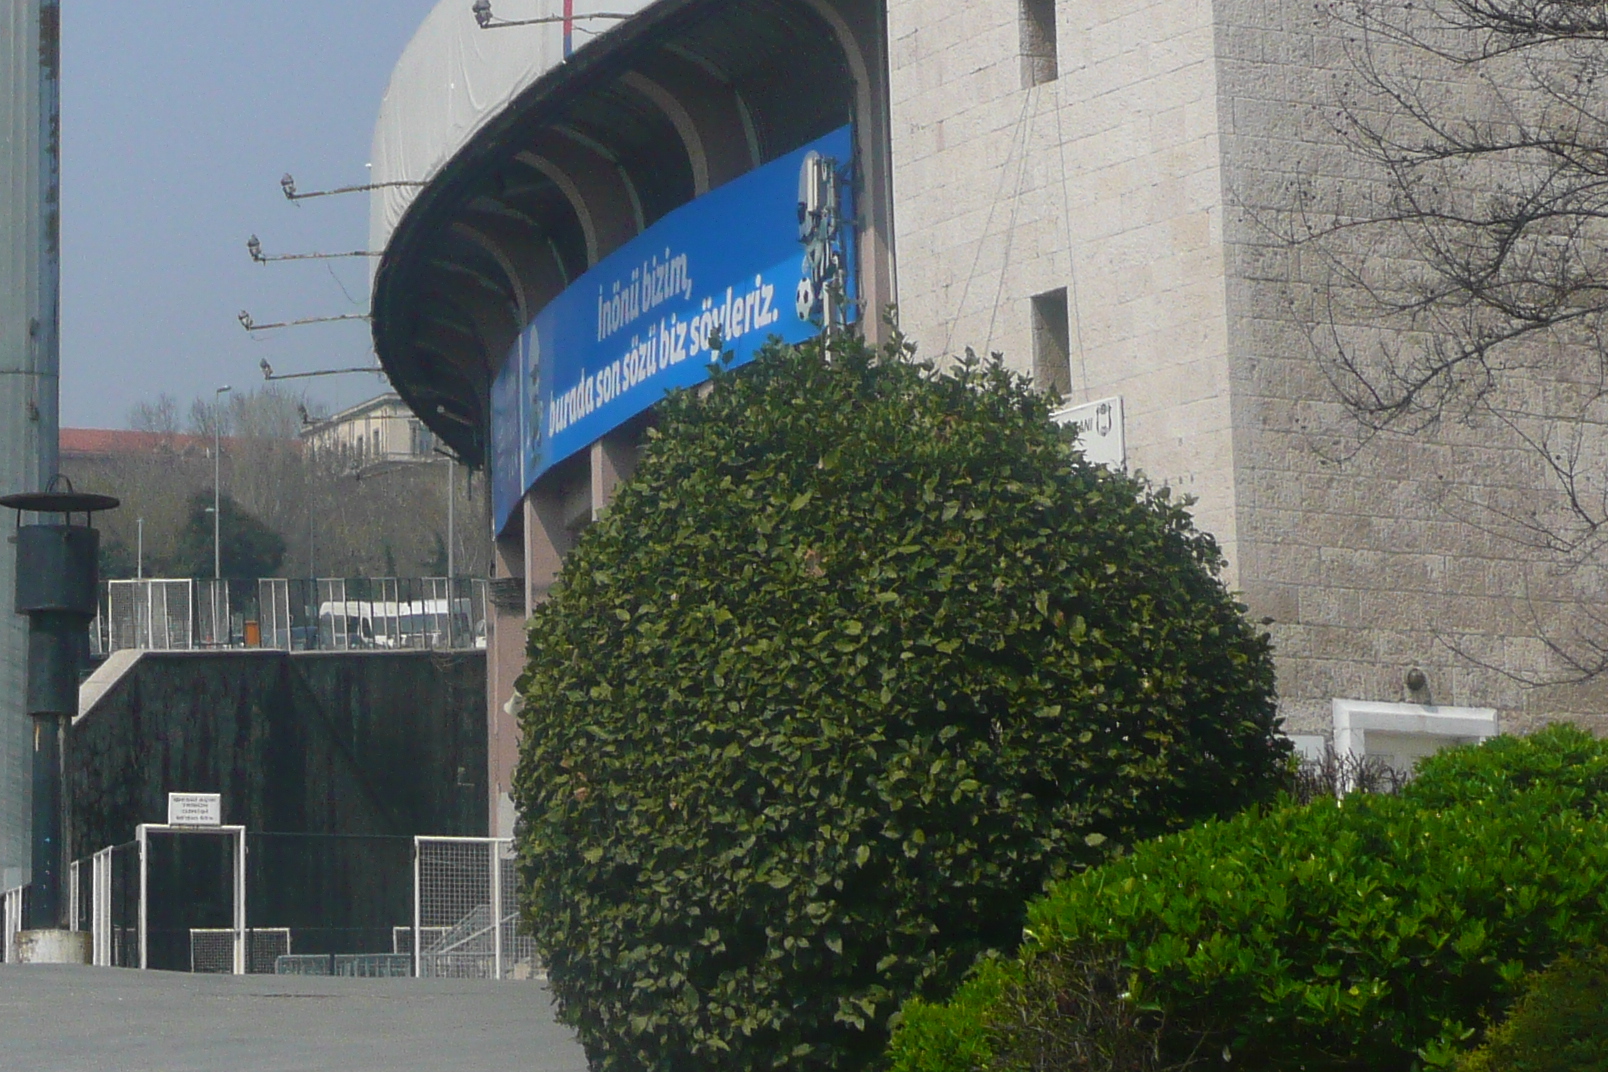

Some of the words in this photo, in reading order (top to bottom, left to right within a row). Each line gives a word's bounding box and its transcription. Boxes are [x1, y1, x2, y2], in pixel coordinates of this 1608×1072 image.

[548, 368, 594, 438] burada
[595, 360, 621, 408] son
[622, 324, 657, 392] sözü
[659, 313, 687, 370] biz
[689, 273, 779, 362] söyleriz.
[597, 267, 639, 342] İnönü
[641, 246, 692, 313] bizim,
